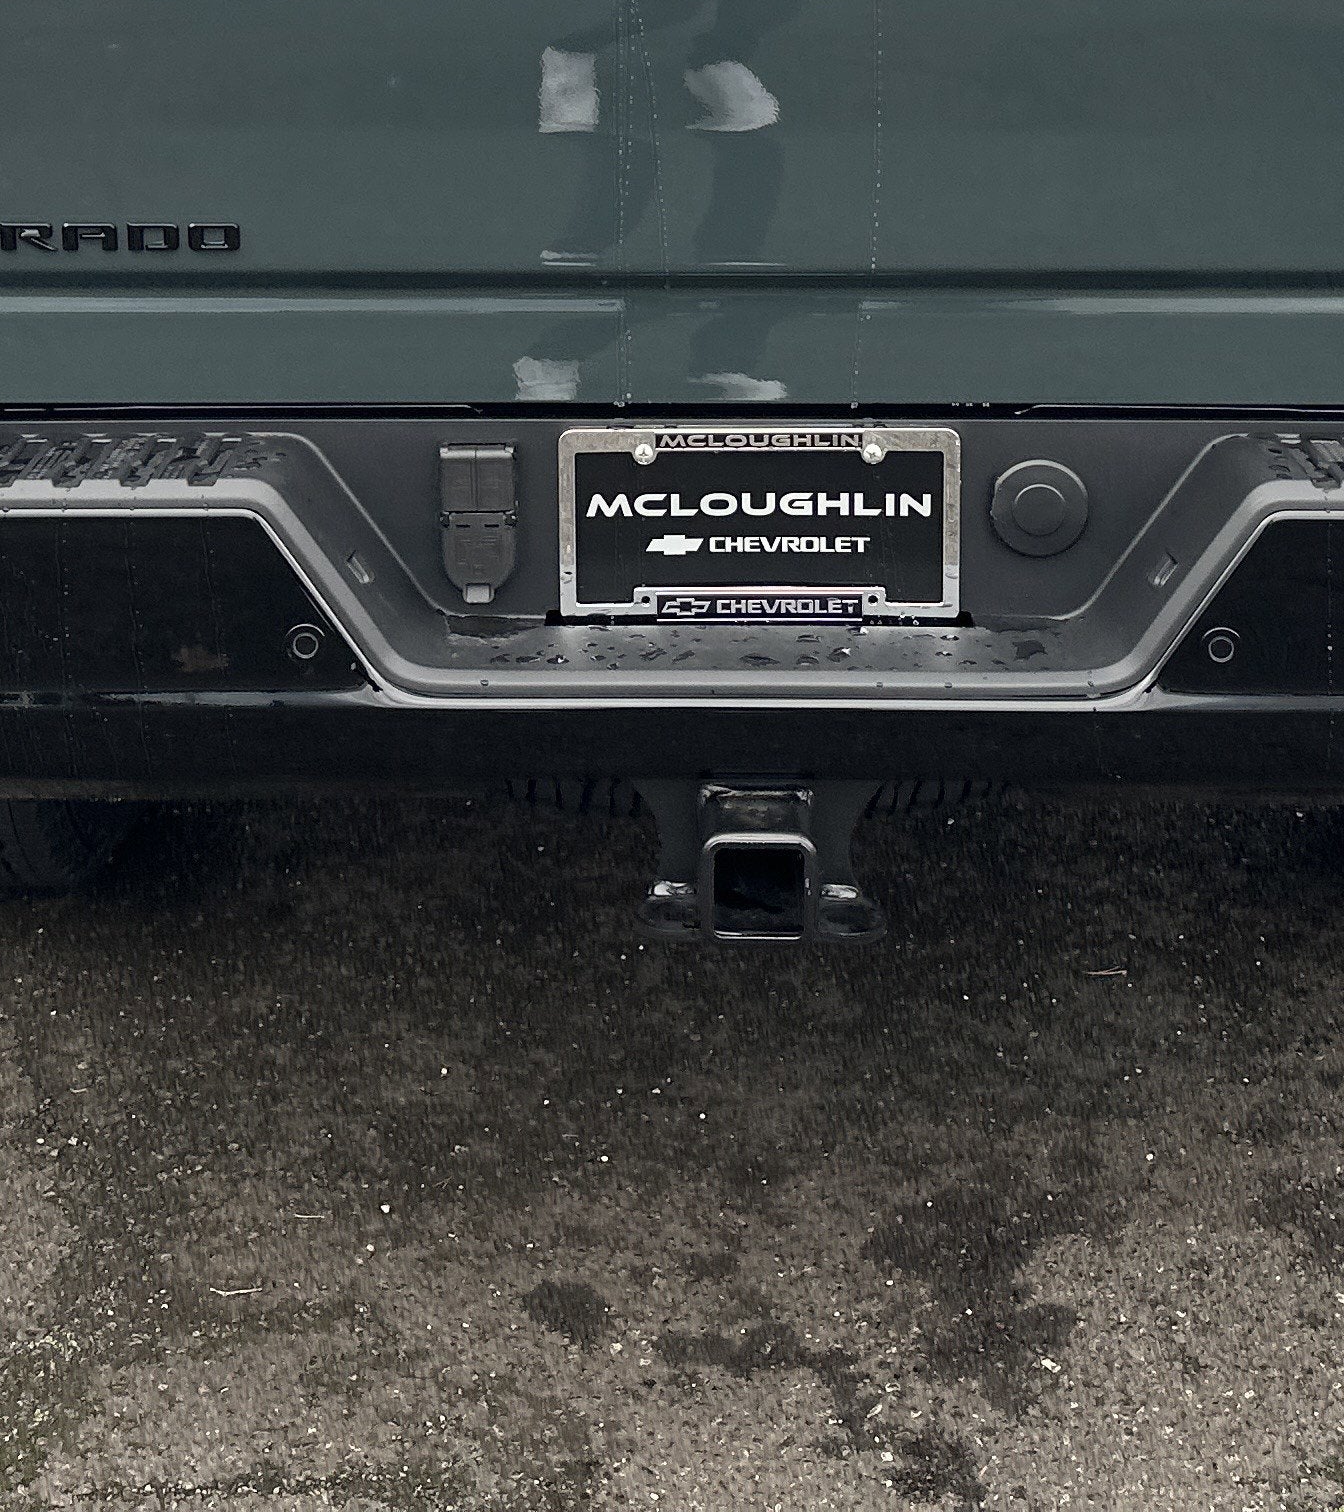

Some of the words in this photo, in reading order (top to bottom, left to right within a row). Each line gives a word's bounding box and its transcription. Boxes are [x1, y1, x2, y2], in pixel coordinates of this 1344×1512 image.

[659, 433, 860, 448] MCLOUGHLIN
[585, 492, 932, 518] MCLOUGHLIN
[708, 535, 871, 554] CHEVROLET
[715, 598, 860, 615] CHEVROLET
